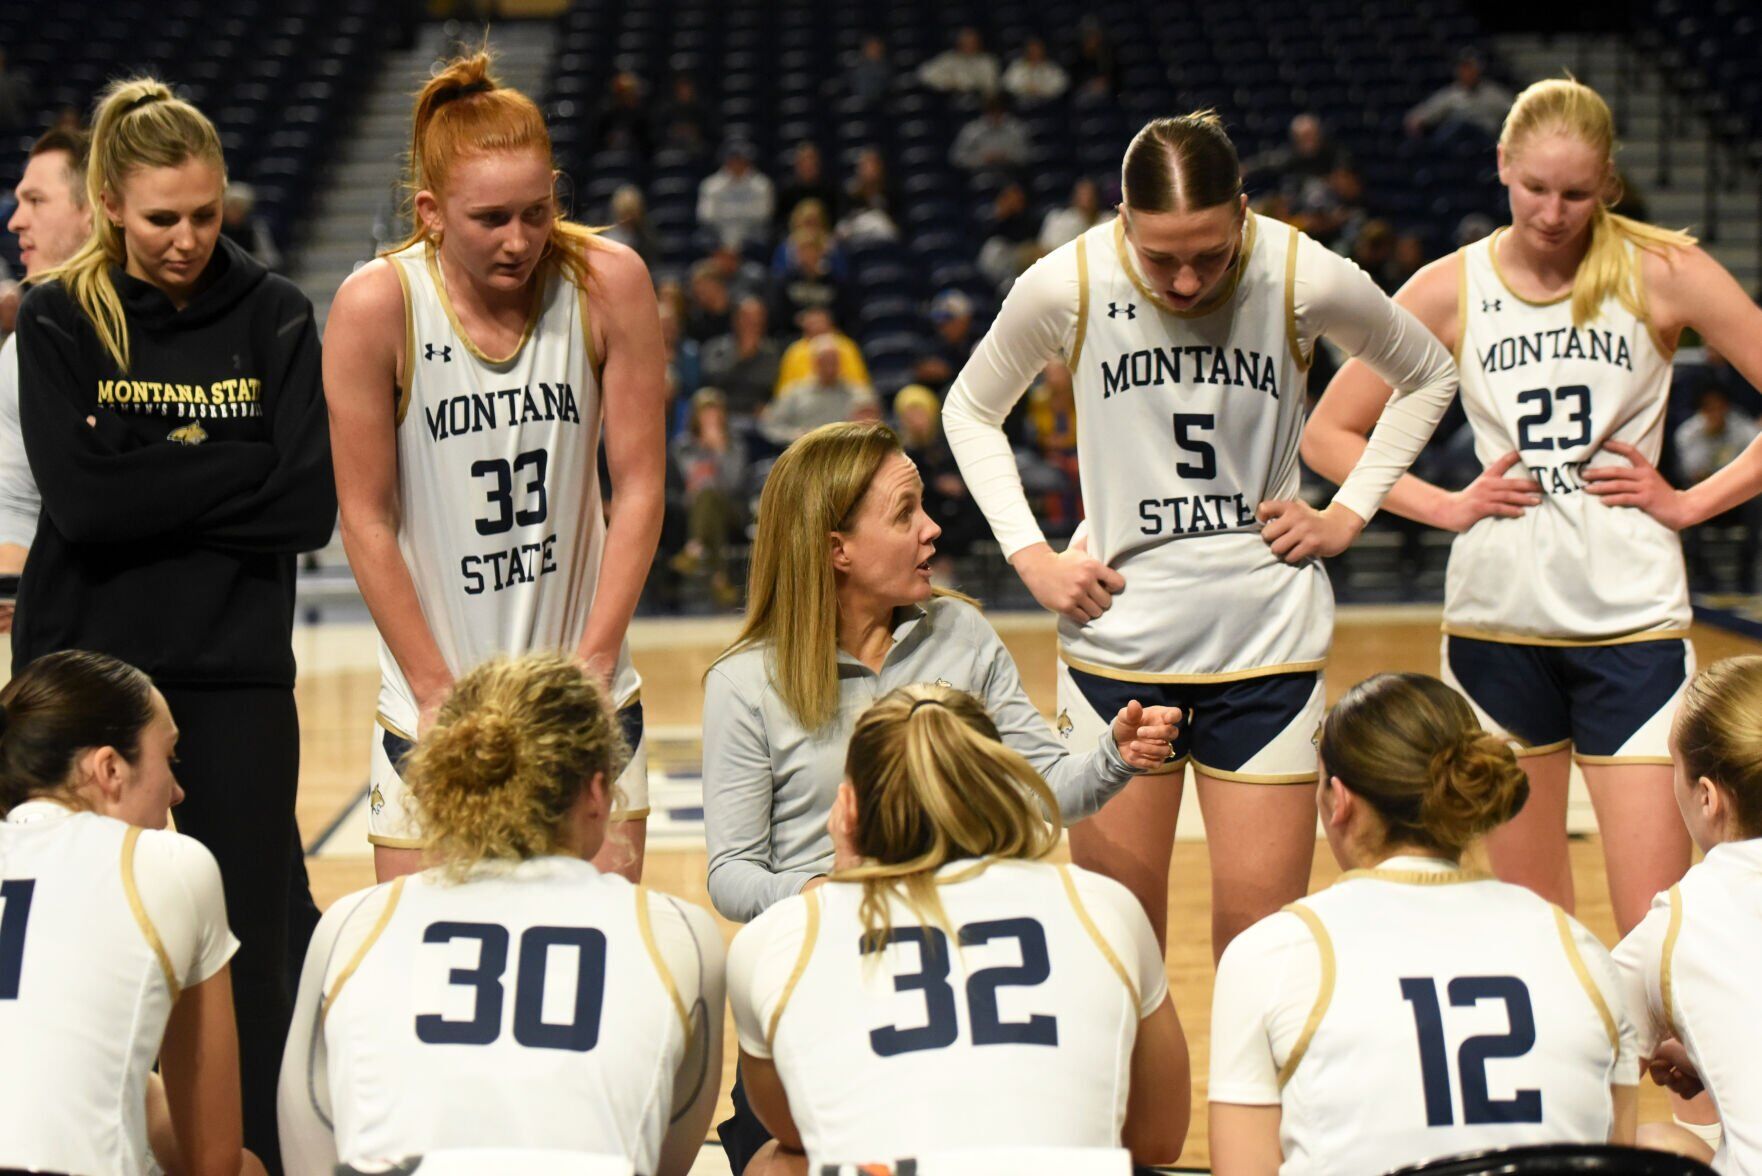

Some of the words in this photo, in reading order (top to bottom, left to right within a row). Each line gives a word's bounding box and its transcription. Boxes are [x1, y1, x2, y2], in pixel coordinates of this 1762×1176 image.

[1101, 345, 1279, 400] MONTANA
[1476, 326, 1633, 372] MONTANA
[98, 380, 209, 404] MONTANA
[425, 382, 580, 442] MONTANA
[1517, 384, 1592, 450] 23
[1173, 413, 1217, 480] 5
[471, 448, 548, 536] 33
[1139, 492, 1257, 535] STATE
[461, 534, 557, 595] STATE
[415, 920, 607, 1053] 30
[859, 917, 1058, 1057] 32
[1398, 975, 1543, 1127] 12
